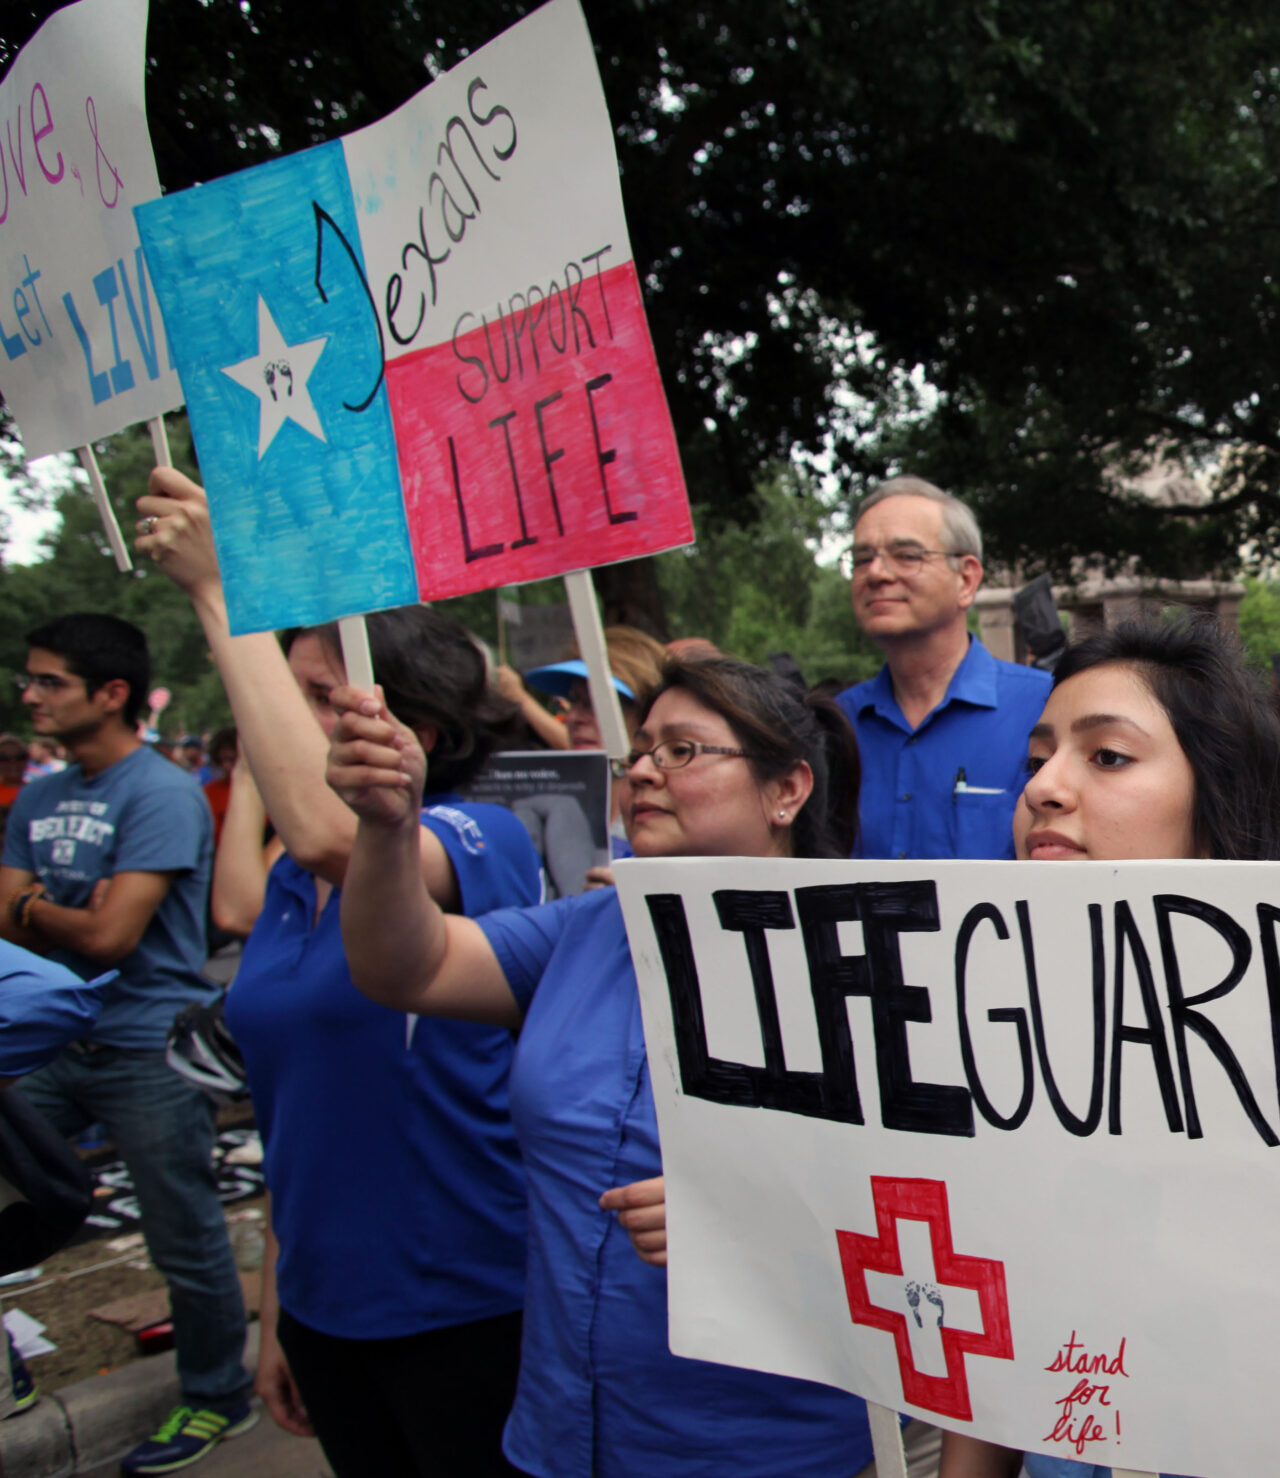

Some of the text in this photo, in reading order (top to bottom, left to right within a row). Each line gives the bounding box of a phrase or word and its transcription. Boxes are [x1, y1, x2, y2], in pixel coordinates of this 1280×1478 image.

[86, 96, 124, 209] &
[312, 77, 518, 412] Texans
[62, 245, 177, 406] LIV
[452, 244, 612, 403] SUPPORT
[448, 372, 638, 563] LIFE
[1043, 1330, 1129, 1378] stand
[1055, 1378, 1111, 1419] for
[1042, 1409, 1121, 1455] life!
